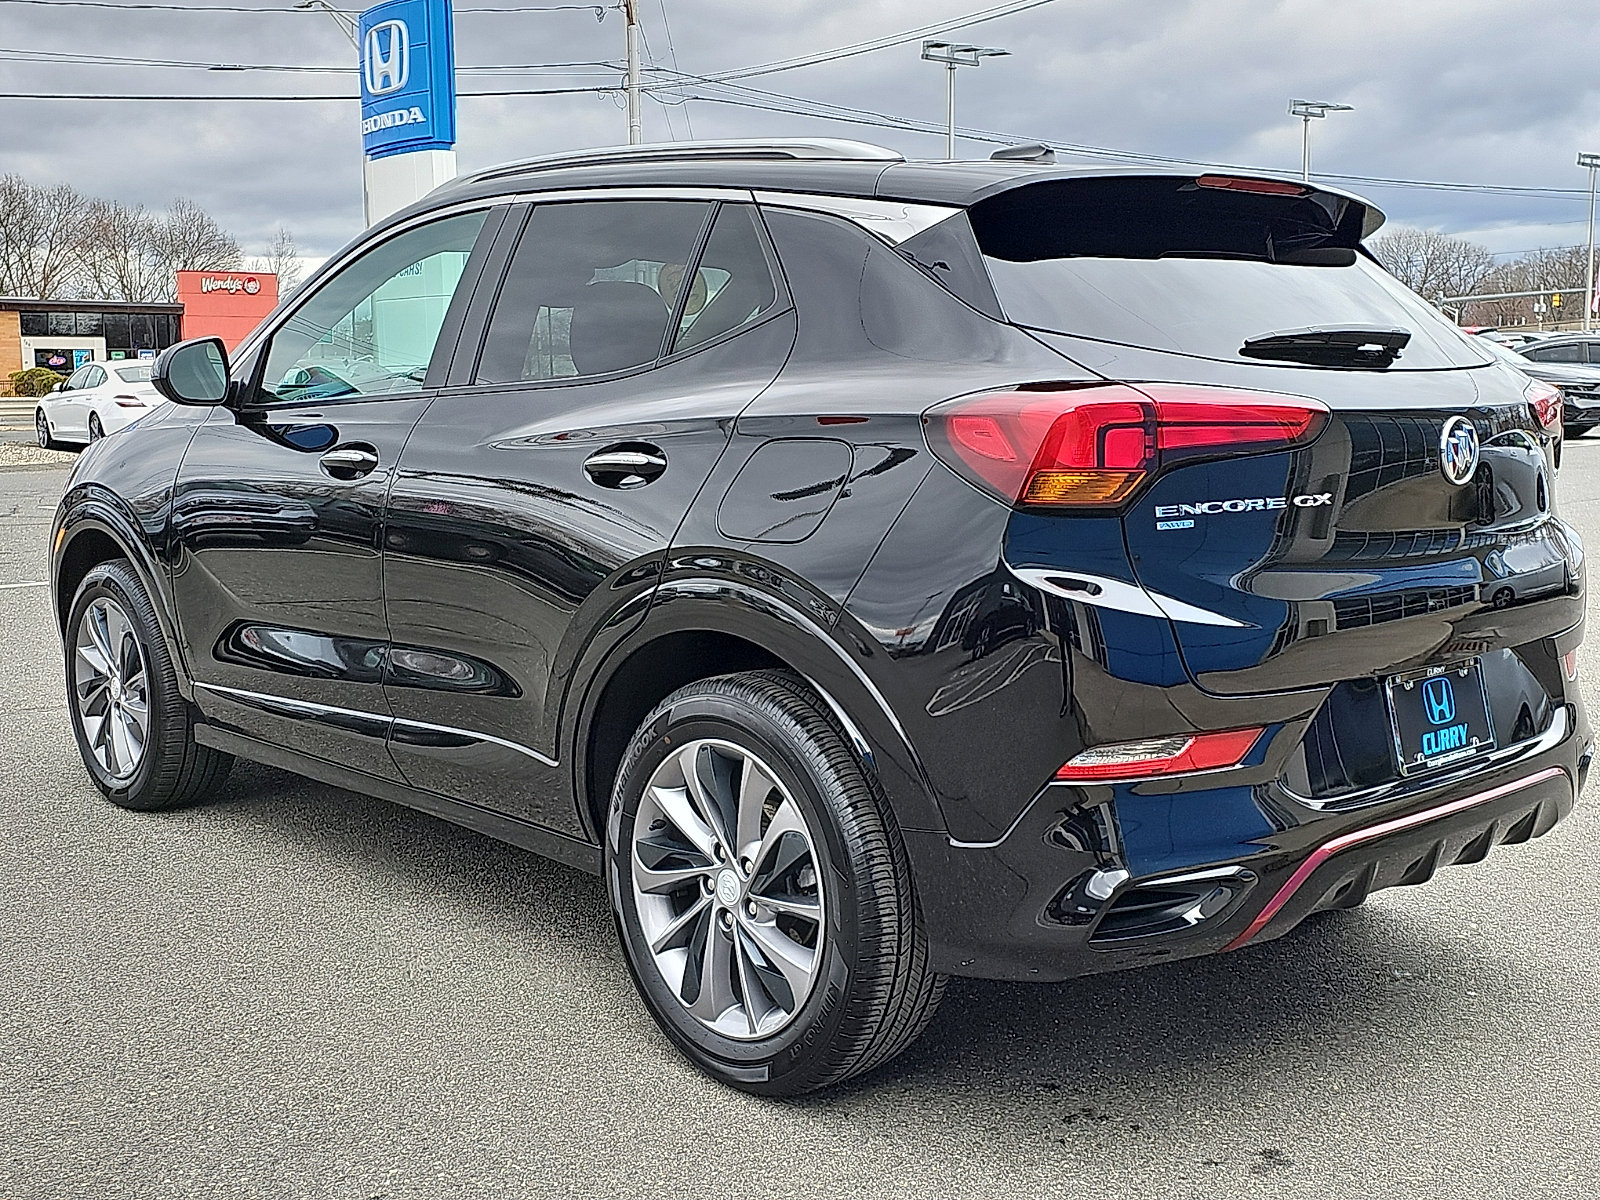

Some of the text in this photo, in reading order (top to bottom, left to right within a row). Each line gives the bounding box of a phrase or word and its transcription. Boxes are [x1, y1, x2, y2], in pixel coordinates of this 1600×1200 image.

[361, 106, 427, 135] HONDA
[201, 275, 243, 295] Wendy's
[1155, 492, 1333, 518] ENCORE GX
[1157, 519, 1194, 530] AWD
[1422, 723, 1468, 756] CURRY
